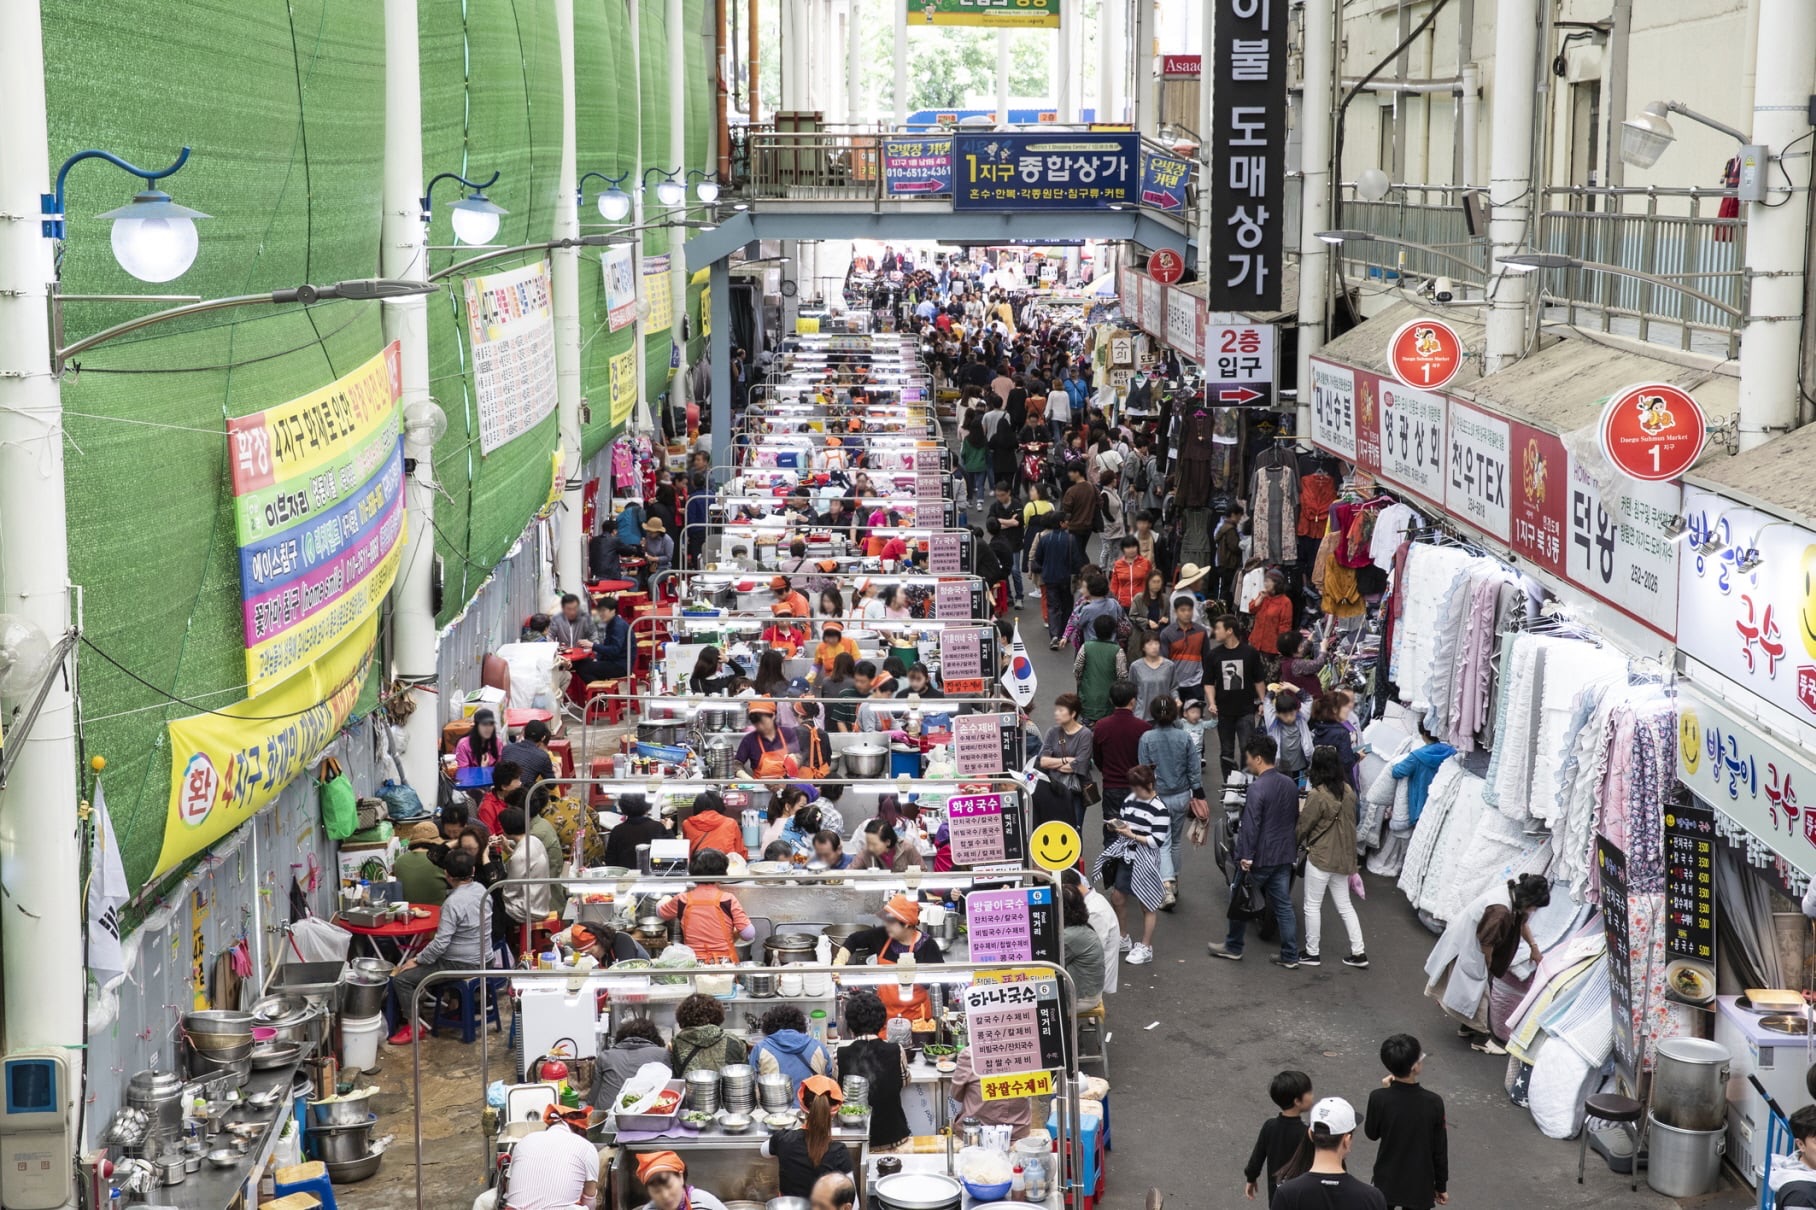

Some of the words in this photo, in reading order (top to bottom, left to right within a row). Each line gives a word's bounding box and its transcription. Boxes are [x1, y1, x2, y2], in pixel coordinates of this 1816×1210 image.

[965, 154, 1015, 183] 1지구
[1018, 155, 1129, 183] 종합상가
[1227, 106, 1270, 296] 도매상가
[1161, 271, 1170, 283] 1
[1220, 329, 1262, 354] 2층
[1218, 356, 1263, 379] 입구
[1420, 363, 1430, 384] 1
[237, 426, 268, 477] 확장
[273, 414, 305, 463] 4지구
[1384, 408, 1441, 474] 영광상회
[1648, 444, 1660, 472] 1
[1452, 439, 1505, 509] 천우TEX
[264, 491, 311, 528] 이브자리
[1515, 518, 1537, 549] 1지구
[252, 539, 299, 585] 에이스침구
[1735, 594, 1785, 677] 국수
[220, 745, 263, 810] 4지구
[1706, 727, 1757, 797] 방글이
[1764, 762, 1800, 835] 국수
[187, 767, 213, 819] 환
[975, 797, 999, 812] 국수
[1003, 813, 1013, 836] 먹거리
[974, 913, 1025, 925] 잔치국수/칼국수
[975, 926, 1026, 938] 비빔국수/수제비
[1032, 911, 1042, 936] 먹거리
[967, 985, 1037, 1008] 하나국수
[975, 1011, 1031, 1025] 칼국수/수제비
[1040, 1008, 1052, 1037] 먹거리
[977, 1026, 1032, 1040] 콩국수/칼제비
[979, 1041, 1034, 1054] 비빔국수/잔치국수
[985, 1056, 1032, 1068] 찹쌀수제비
[985, 1076, 1049, 1099] 찹쌀수제비
